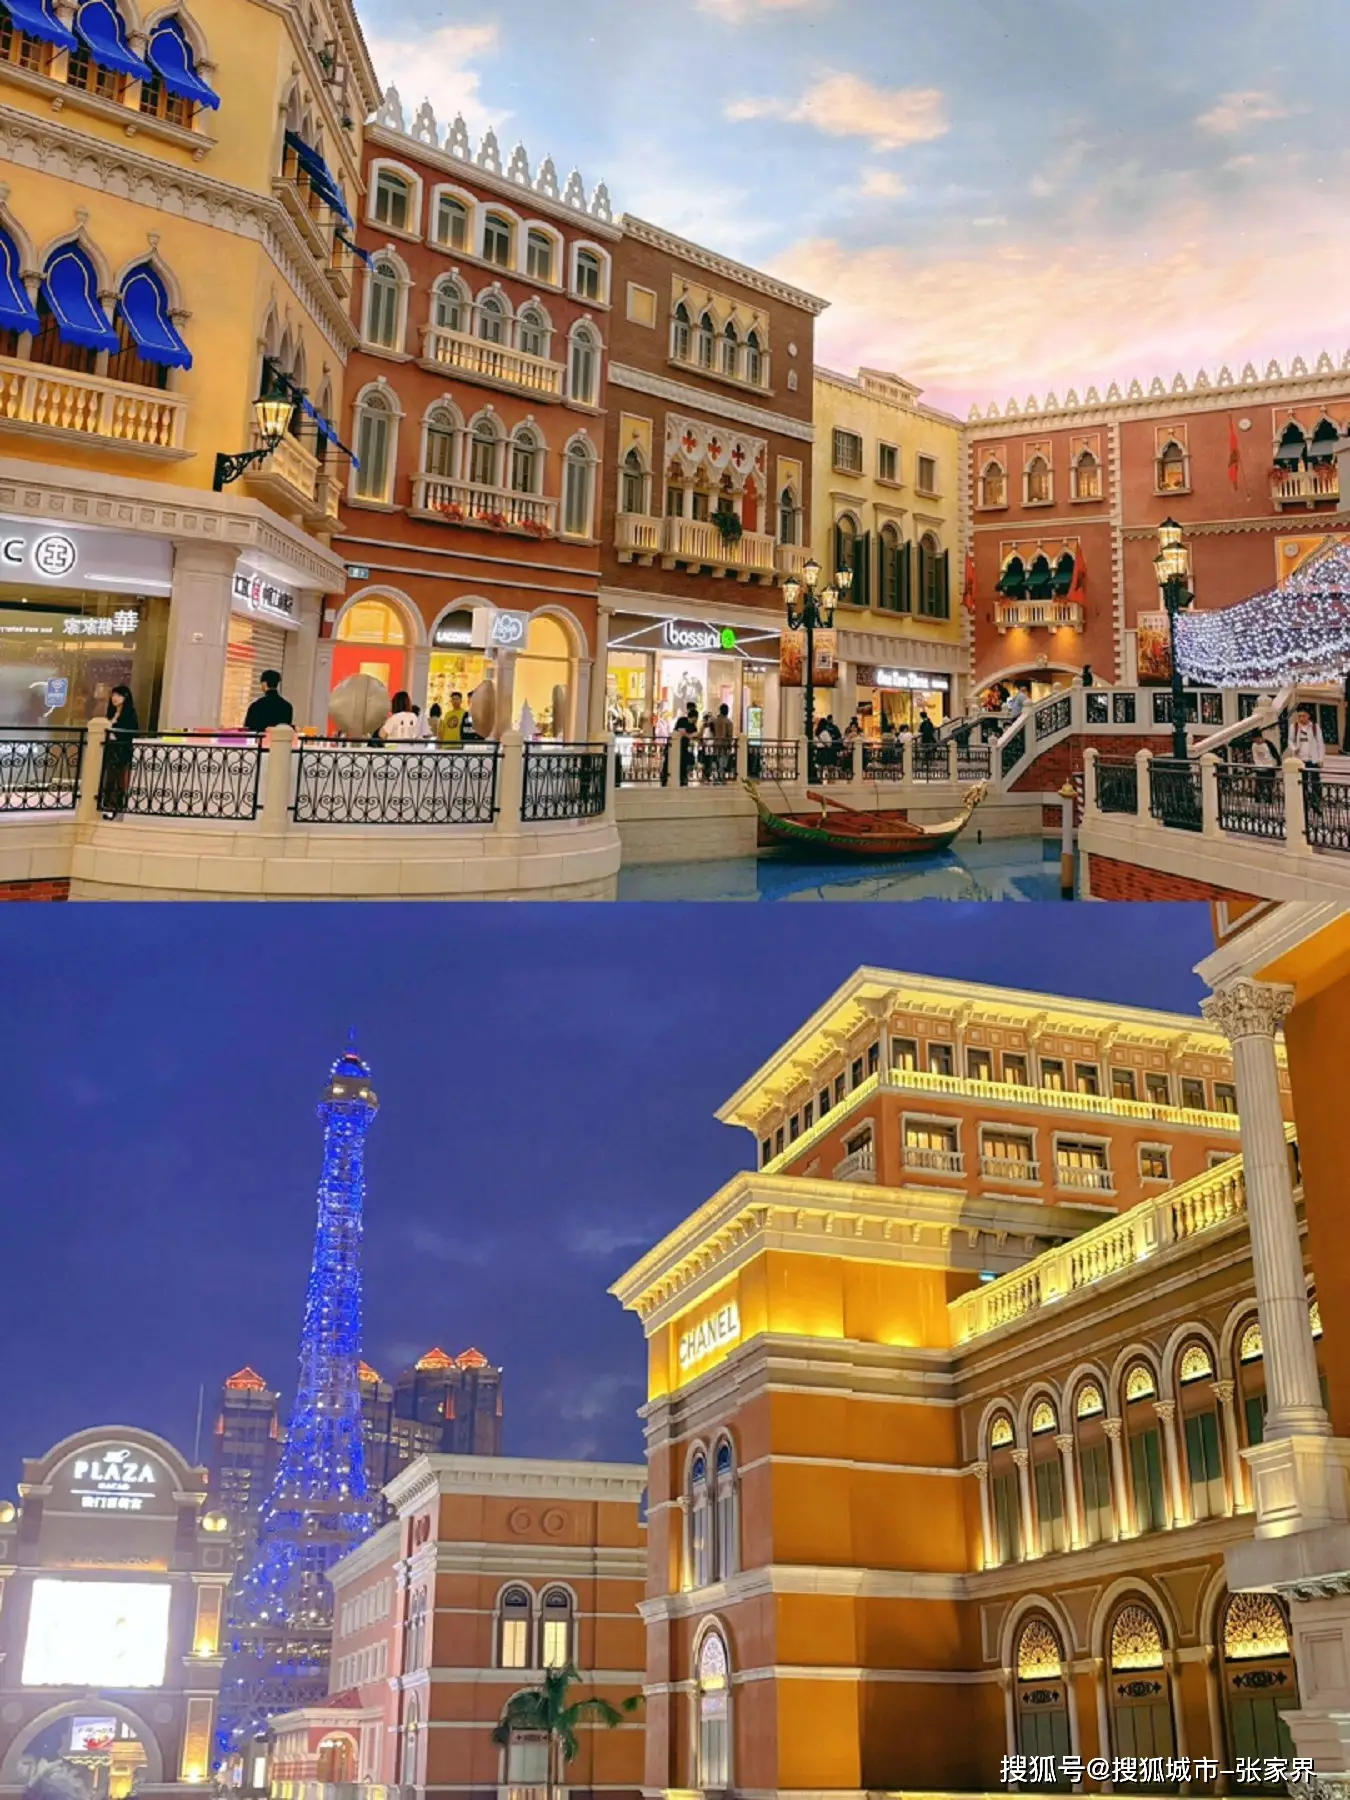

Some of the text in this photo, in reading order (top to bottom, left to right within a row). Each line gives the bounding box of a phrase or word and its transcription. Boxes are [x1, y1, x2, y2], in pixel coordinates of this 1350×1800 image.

[665, 622, 721, 648] bossini
[679, 1303, 738, 1366] CHANEL
[74, 1461, 155, 1483] PLAZA
